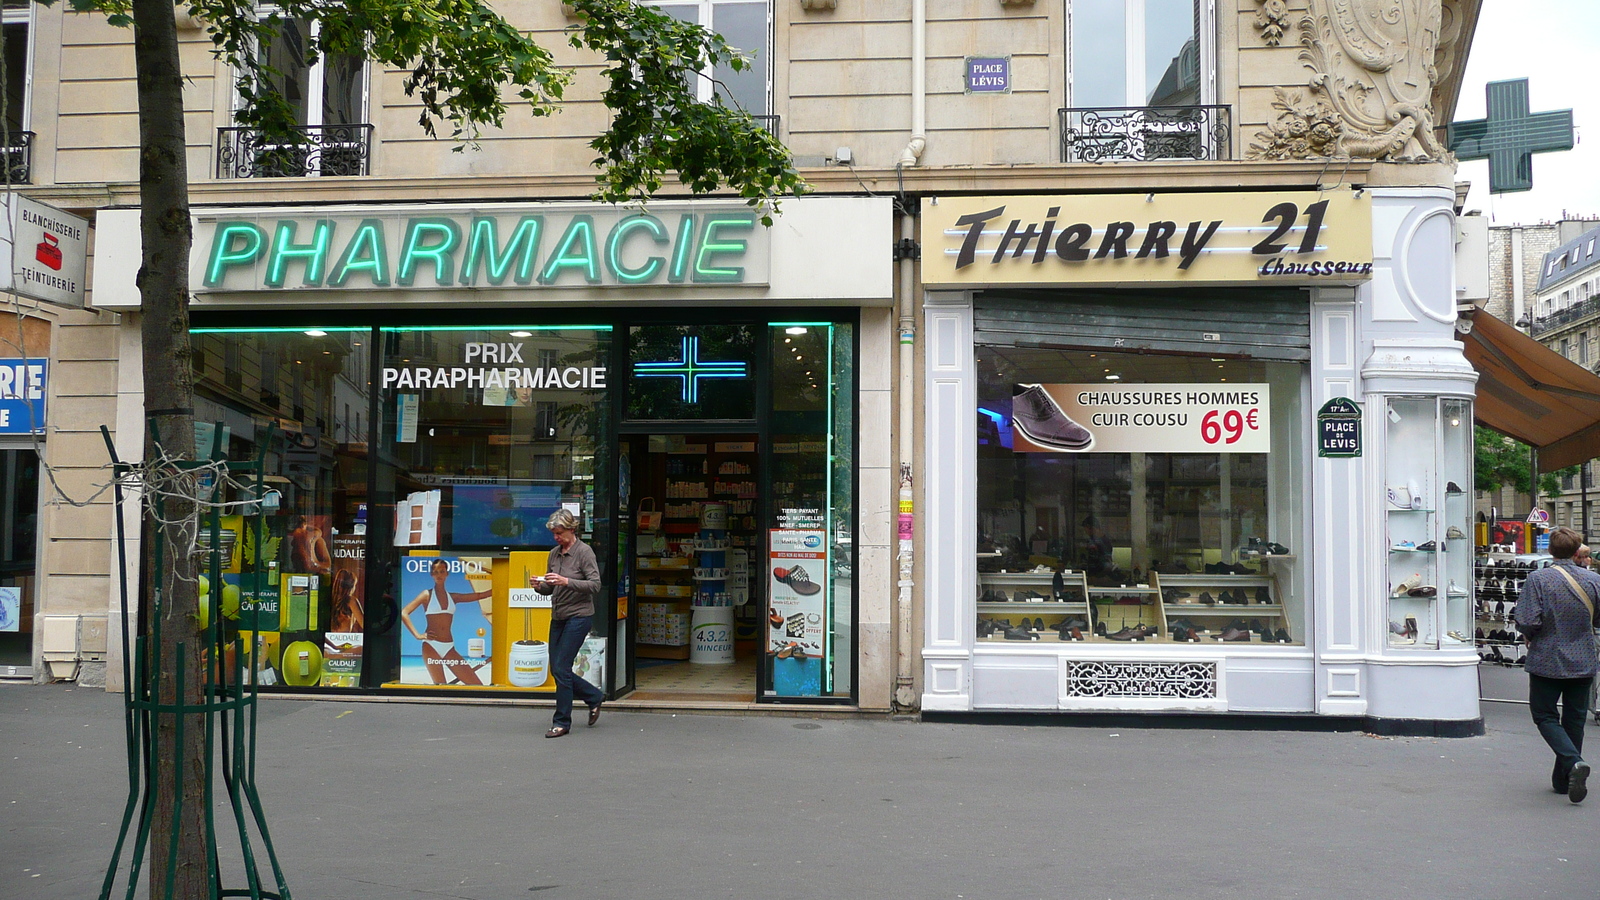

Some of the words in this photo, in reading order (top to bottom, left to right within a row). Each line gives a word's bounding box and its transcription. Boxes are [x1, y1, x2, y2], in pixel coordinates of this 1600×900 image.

[973, 64, 1003, 74] PLACE
[972, 75, 1005, 86] LÉVIS
[1251, 199, 1330, 256] 21
[203, 213, 757, 289] PHARMACIE
[464, 342, 524, 364] PRIX
[382, 366, 608, 389] PARAPHARMACIE
[1077, 391, 1183, 406] CHAUSSURES
[1185, 391, 1260, 406] HOMMES
[1092, 412, 1131, 427] CUIR
[1133, 412, 1189, 427] COUSU
[1325, 422, 1355, 432] PLACE
[1324, 439, 1356, 448] LEVIS
[511, 593, 552, 602] OENOBIO
[427, 657, 459, 666] Bronzage
